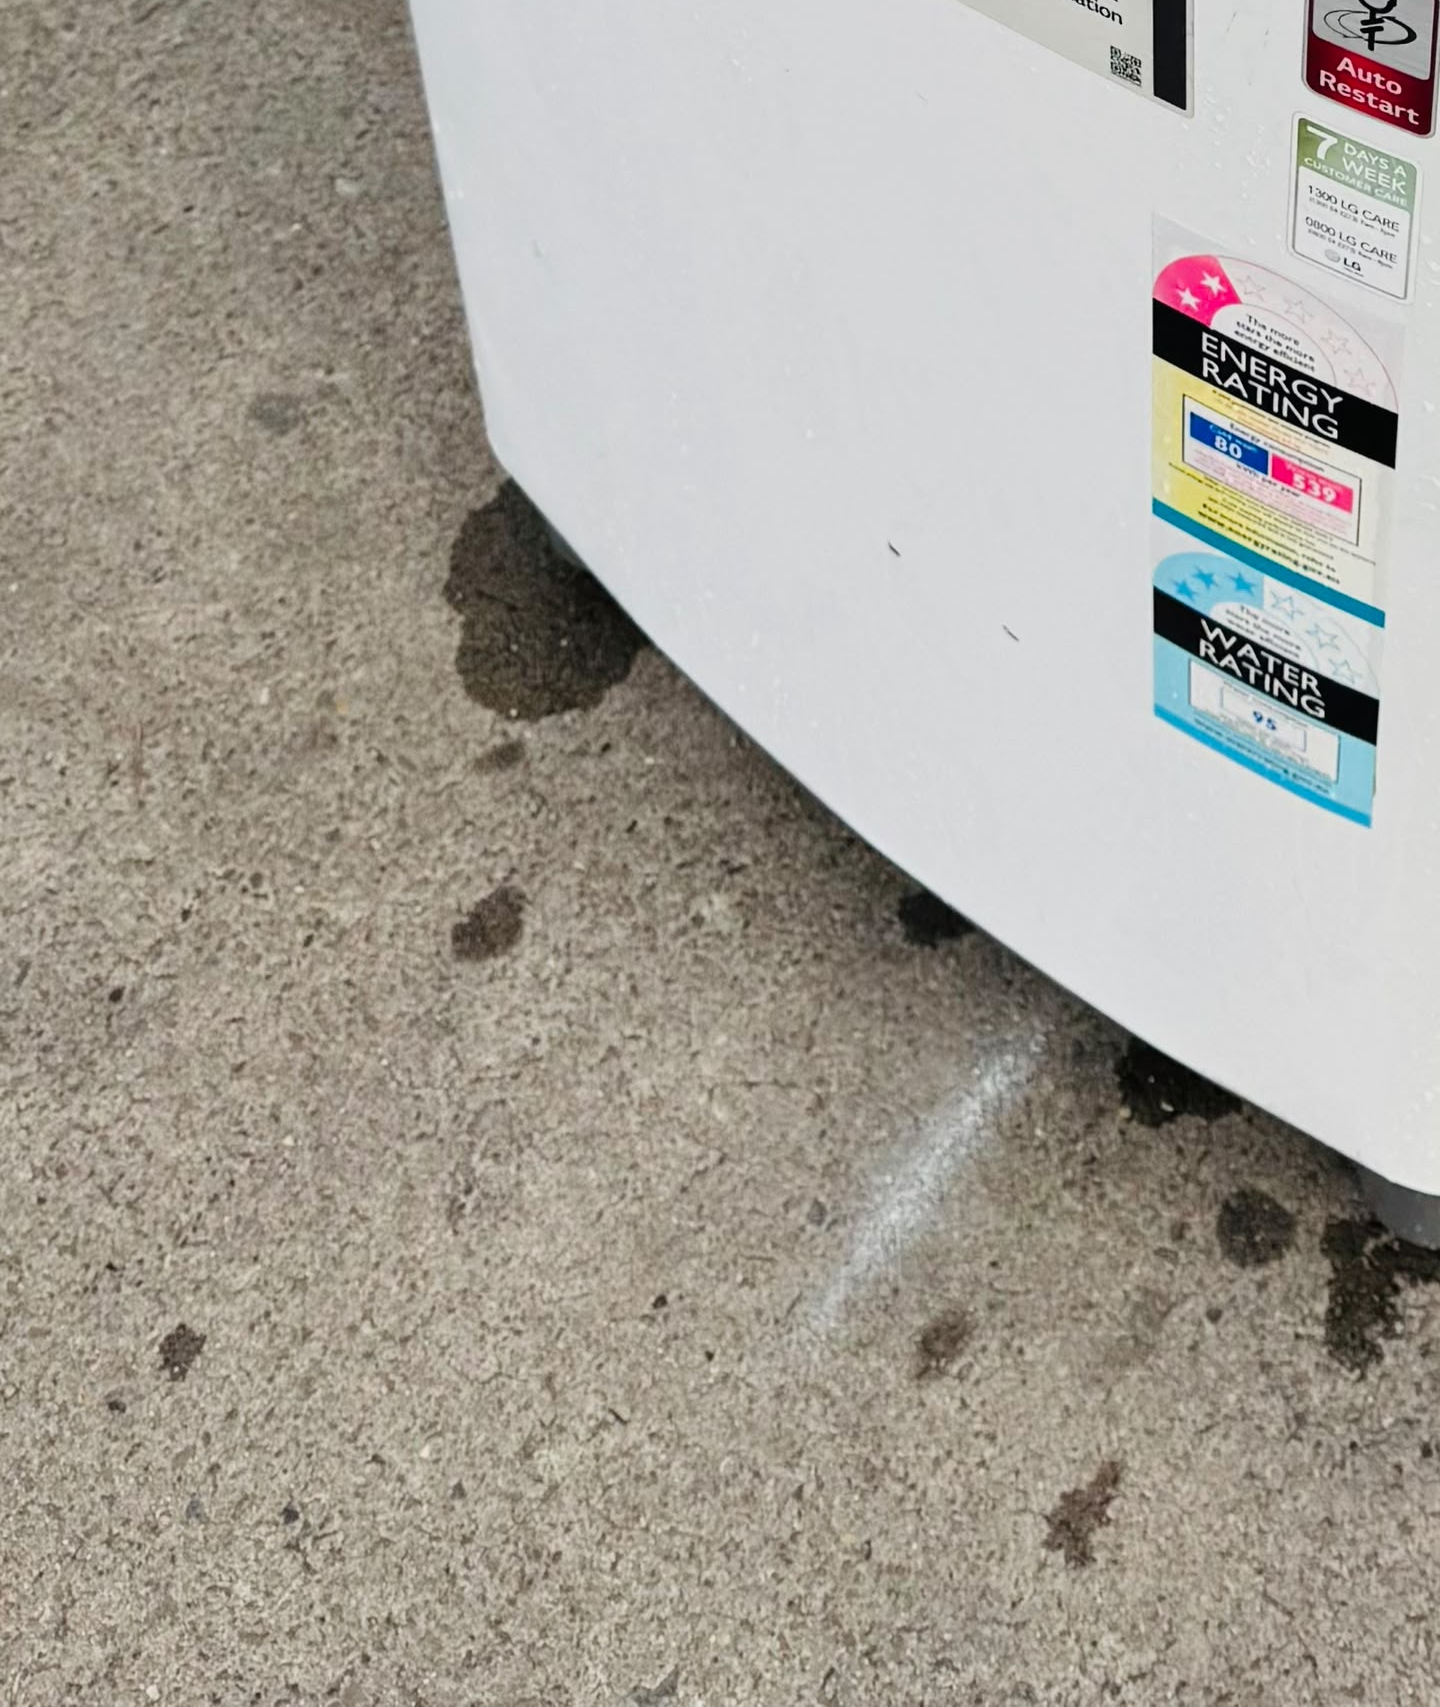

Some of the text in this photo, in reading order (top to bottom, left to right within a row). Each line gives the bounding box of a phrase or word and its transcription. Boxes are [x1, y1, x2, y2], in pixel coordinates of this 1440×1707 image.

[1336, 56, 1402, 95] Auto
[1319, 69, 1419, 125] Restart
[1306, 125, 1338, 160] 7
[1344, 142, 1407, 178] DAYS A
[1304, 157, 1408, 206] CUSTOMER CARE
[1342, 156, 1407, 195] WEEK
[1309, 185, 1338, 205] 1300
[1341, 200, 1358, 215] LG
[1362, 210, 1400, 233] CARE
[1305, 216, 1336, 237] 0800
[1339, 231, 1357, 247] LG
[1360, 242, 1398, 264] CARE
[1343, 257, 1361, 272] LG
[1270, 328, 1299, 346] more
[1202, 331, 1343, 413] ENERGY
[1202, 359, 1339, 439] RATING
[1214, 435, 1243, 460] 80
[1292, 473, 1337, 503] 539
[1200, 618, 1322, 698] WATER
[1199, 638, 1325, 719] RATING
[1253, 710, 1277, 731] 95
